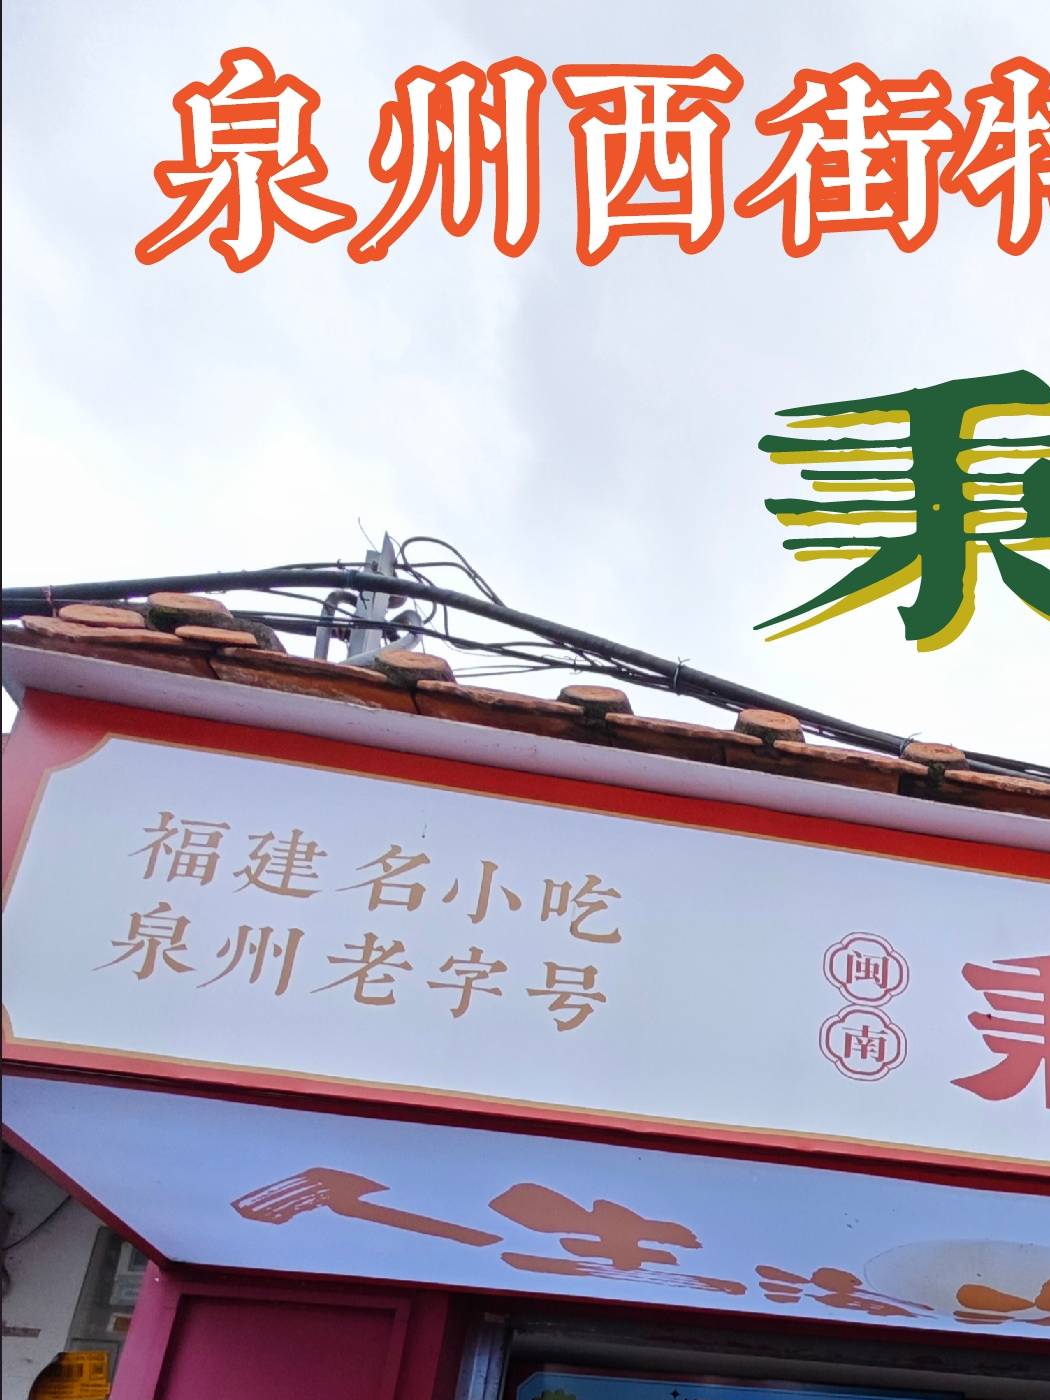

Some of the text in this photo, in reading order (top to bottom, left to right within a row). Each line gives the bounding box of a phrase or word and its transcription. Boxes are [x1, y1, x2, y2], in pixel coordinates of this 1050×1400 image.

[127, 810, 623, 946] 福建名小吃
[92, 901, 608, 1032] 泉州老字号
